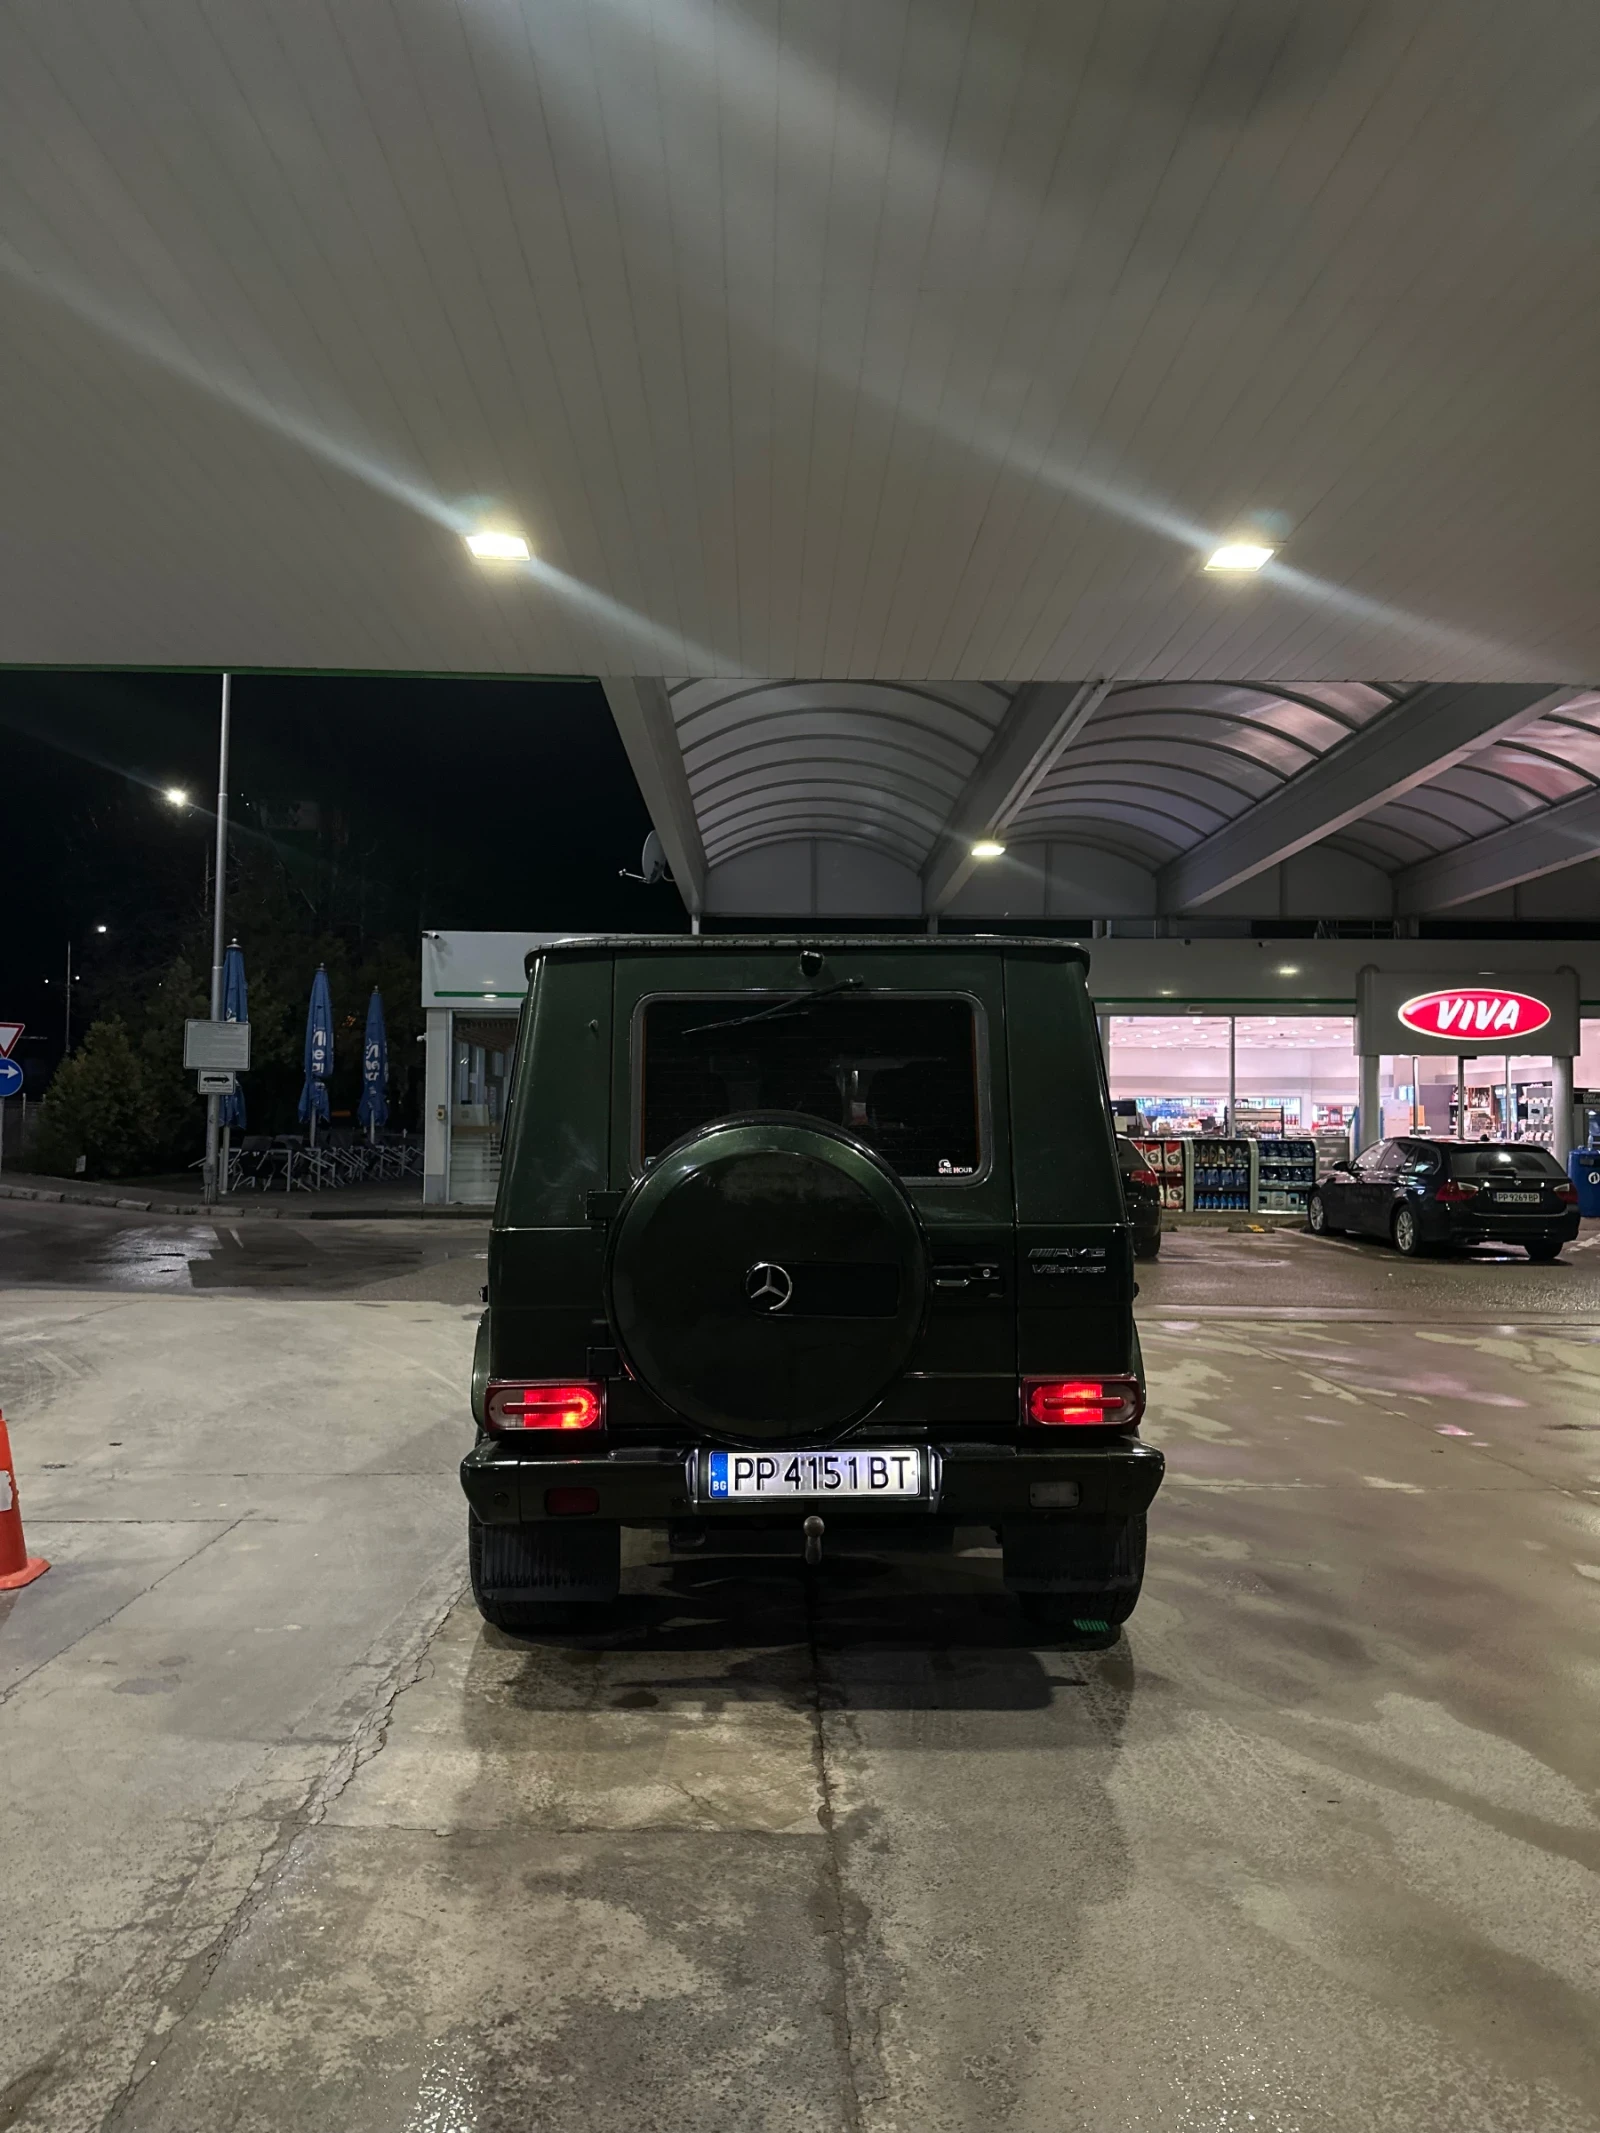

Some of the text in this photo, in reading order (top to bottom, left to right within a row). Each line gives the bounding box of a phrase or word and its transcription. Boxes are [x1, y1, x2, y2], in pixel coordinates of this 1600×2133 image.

[1437, 998, 1519, 1031] VIVA
[713, 1480, 727, 1491] BG
[734, 1456, 911, 1491] PP 4151 BT
